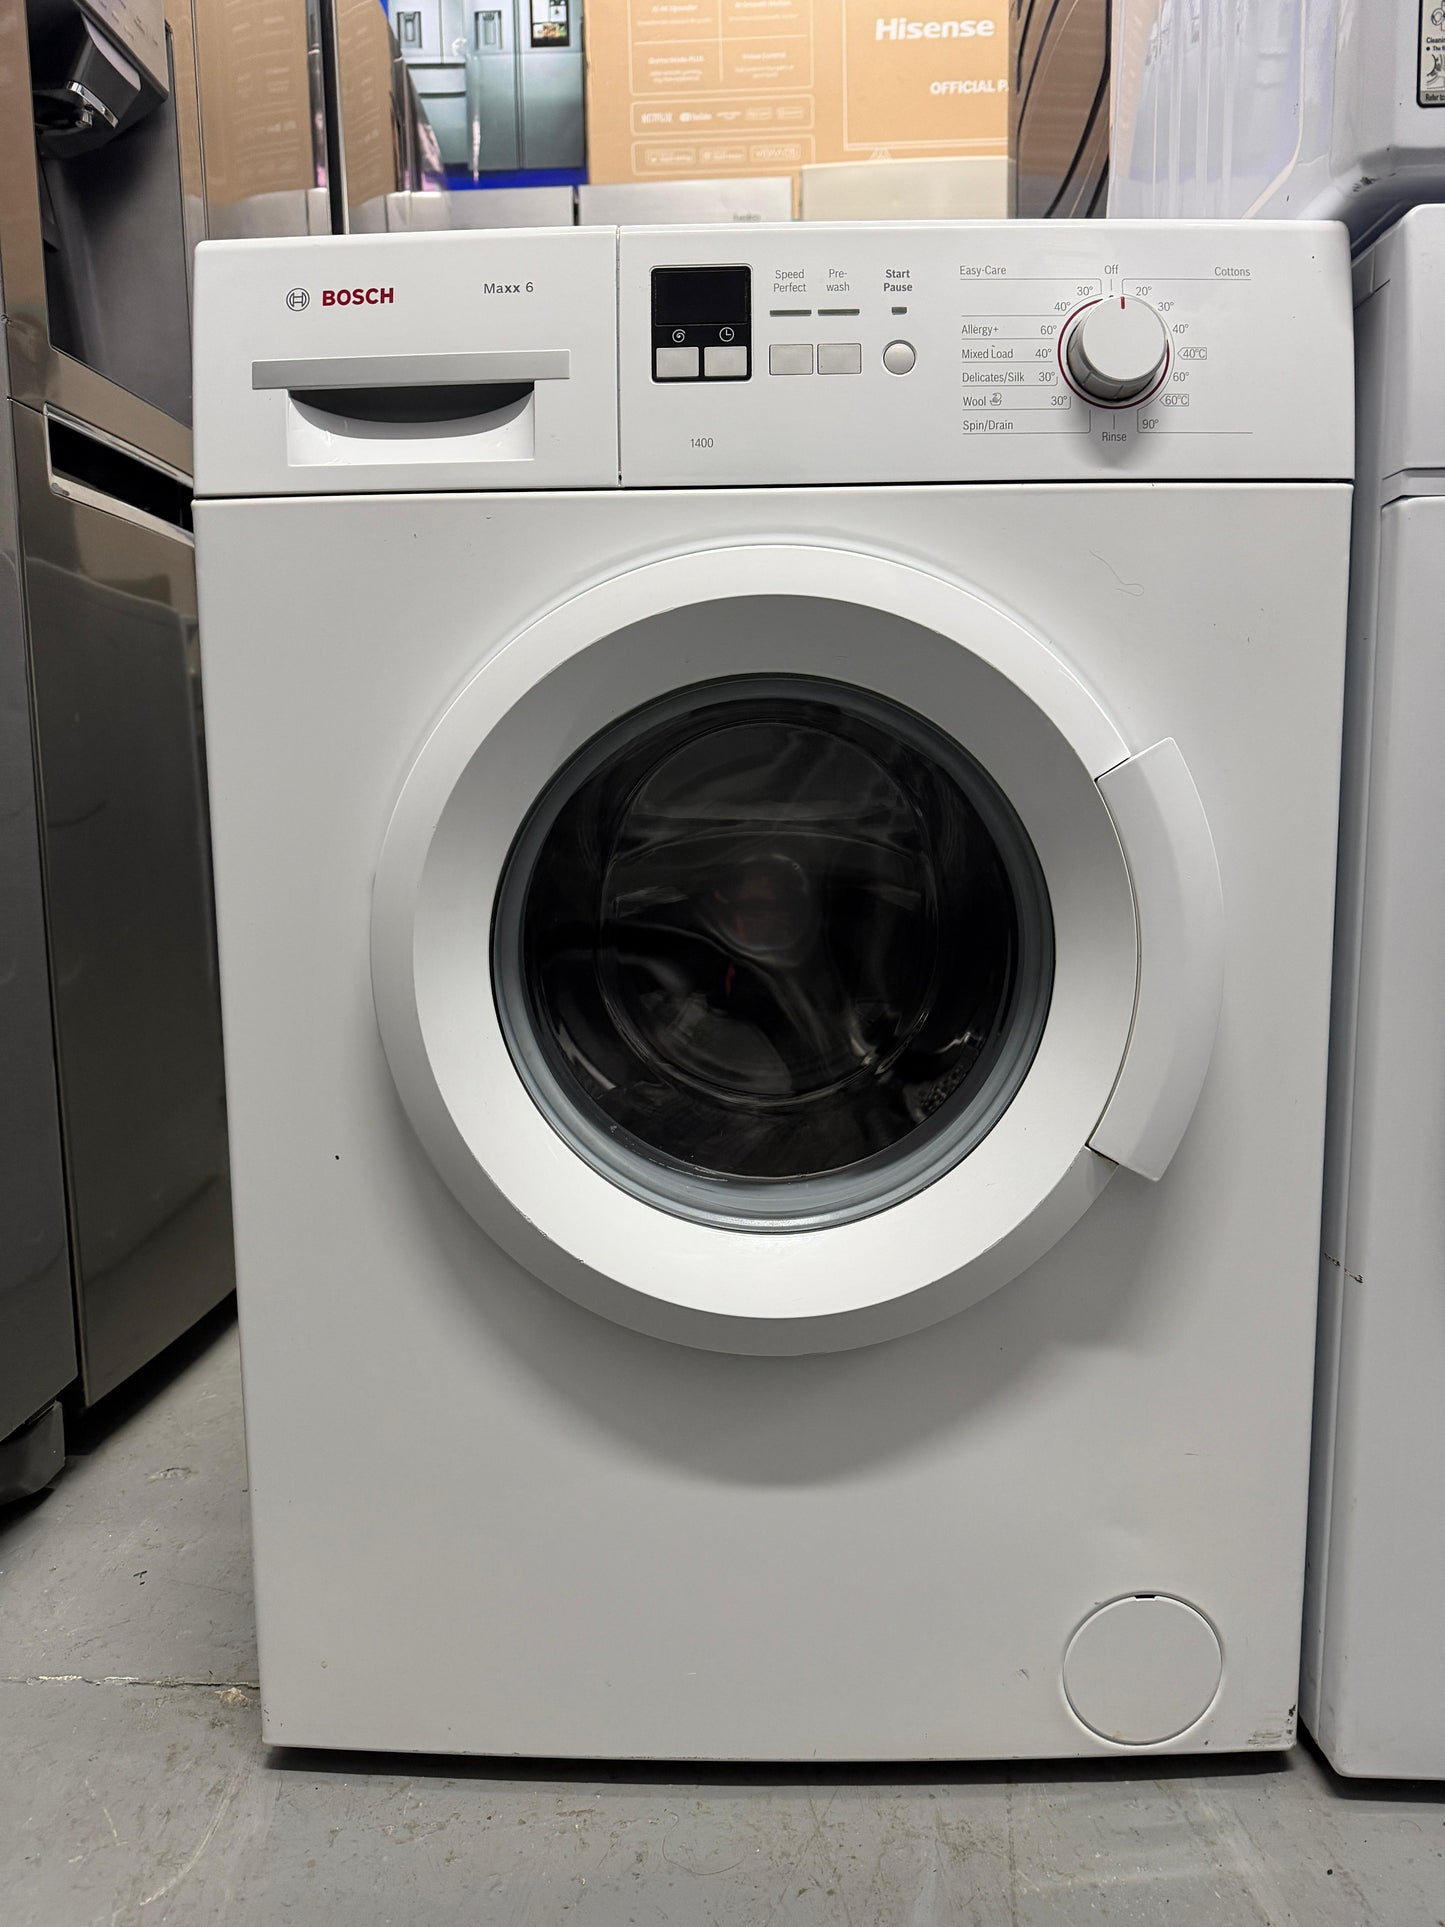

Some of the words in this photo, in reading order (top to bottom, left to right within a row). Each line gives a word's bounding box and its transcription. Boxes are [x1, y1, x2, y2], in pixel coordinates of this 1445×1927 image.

[875, 17, 996, 41] Hisense
[930, 80, 996, 95] OFFICIAL
[998, 79, 1009, 93] P
[775, 269, 805, 281] Speed
[828, 268, 848, 279] Pre-
[885, 269, 910, 279] Start
[959, 265, 1007, 277] Easy-Care
[1104, 264, 1119, 275] Off
[1214, 266, 1251, 277] Cottons
[483, 283, 521, 294] Maxx
[525, 281, 534, 293] 6
[773, 282, 807, 293] Perfect
[826, 282, 850, 292] wash
[883, 282, 913, 292] Pause
[1076, 285, 1094, 297] 30°
[1135, 286, 1153, 297] 20°
[322, 287, 394, 307] BOSCH
[1053, 301, 1071, 312] 40°
[1157, 301, 1175, 312] 30°
[961, 324, 999, 337] Allergy+
[1040, 325, 1057, 335] 60°
[1172, 324, 1189, 334] 40°
[961, 348, 989, 359] Mixed
[991, 348, 1014, 359] Load
[1035, 348, 1052, 359] 40°
[1182, 348, 1206, 359] 40°C
[962, 371, 1025, 383] Delicates/Silk
[1038, 371, 1056, 382] 30°
[1172, 371, 1190, 382] 60°
[963, 396, 987, 407] Wool
[1051, 395, 1068, 406] 30°
[1165, 394, 1188, 405] 60°C
[963, 420, 1014, 432] Spin/Drain
[1142, 419, 1159, 430] 90°
[1101, 431, 1127, 442] Rinse
[690, 438, 714, 448] 1400
